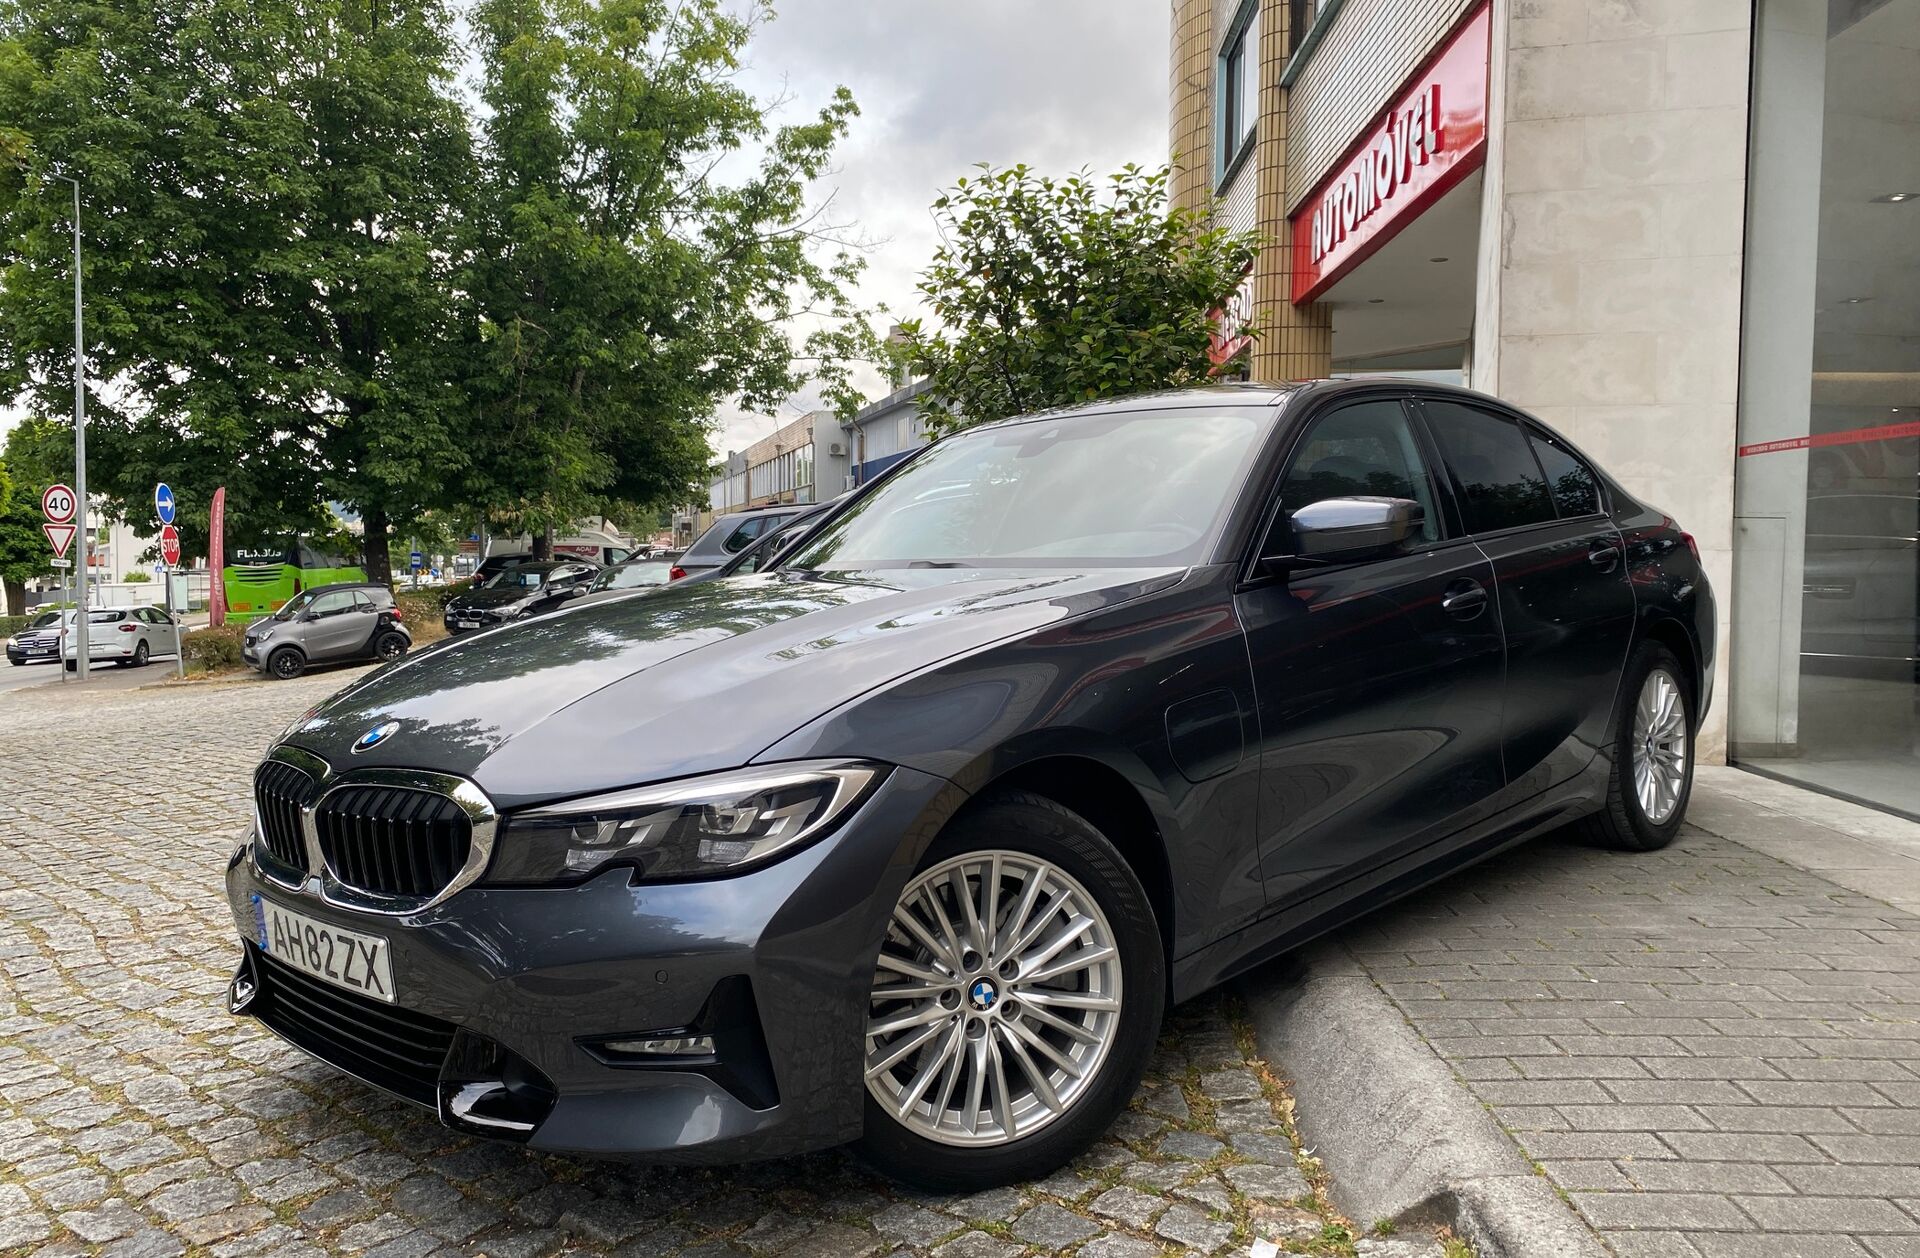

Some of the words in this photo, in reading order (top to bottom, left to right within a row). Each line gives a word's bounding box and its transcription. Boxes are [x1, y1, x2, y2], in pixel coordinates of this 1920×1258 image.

[1312, 84, 1444, 265] AUTOMÓVEL
[48, 497, 70, 511] 40
[163, 538, 179, 553] STOP
[237, 548, 282, 558] FLXBUS
[273, 911, 385, 994] AH82ZX
